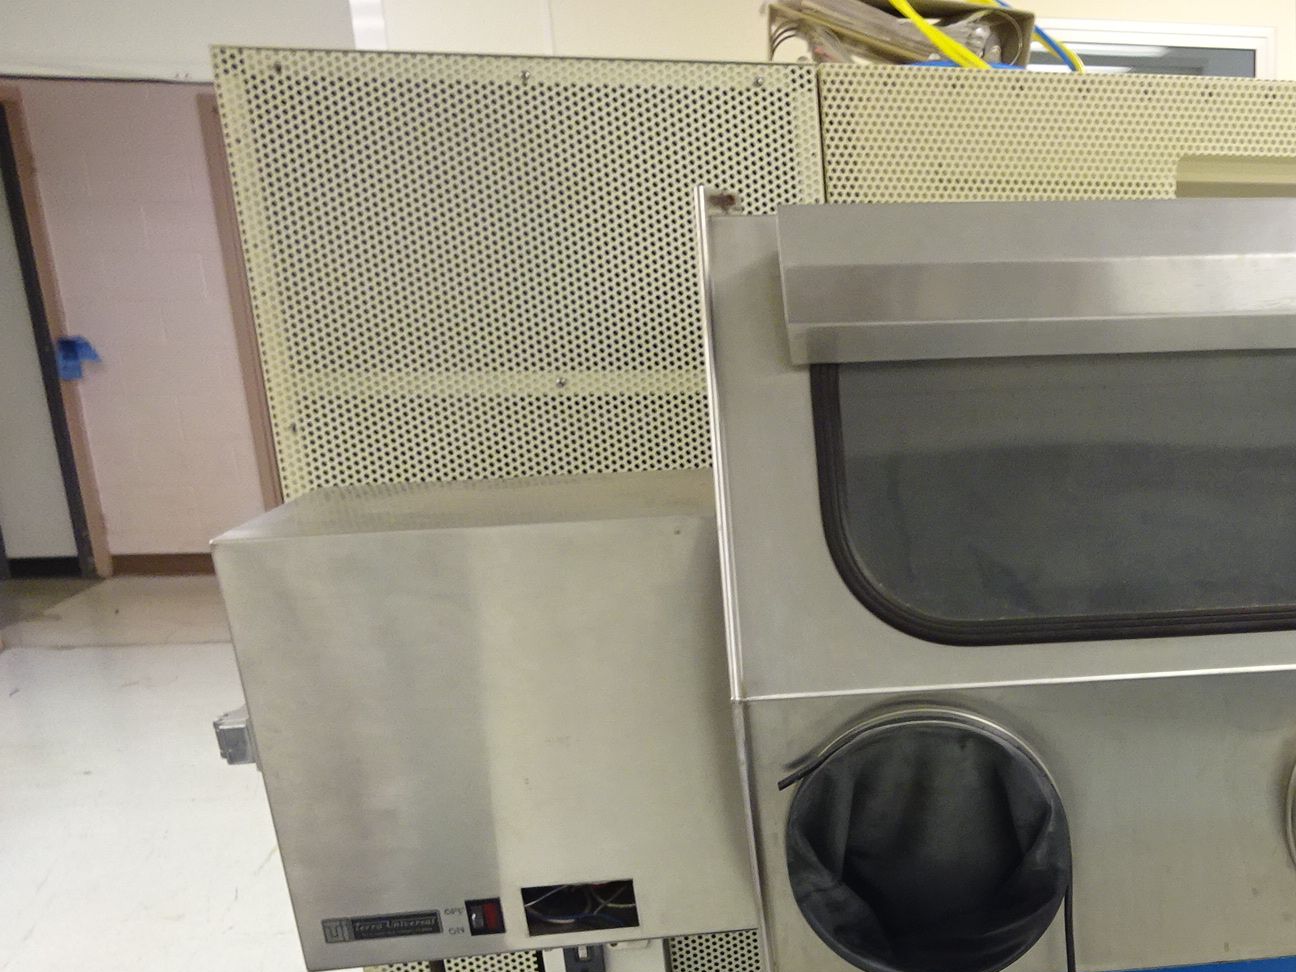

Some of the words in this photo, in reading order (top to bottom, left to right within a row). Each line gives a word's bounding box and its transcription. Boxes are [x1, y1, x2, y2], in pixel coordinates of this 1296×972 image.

[444, 907, 464, 915] OFF
[385, 916, 437, 928] Universal
[448, 927, 465, 935] ON
